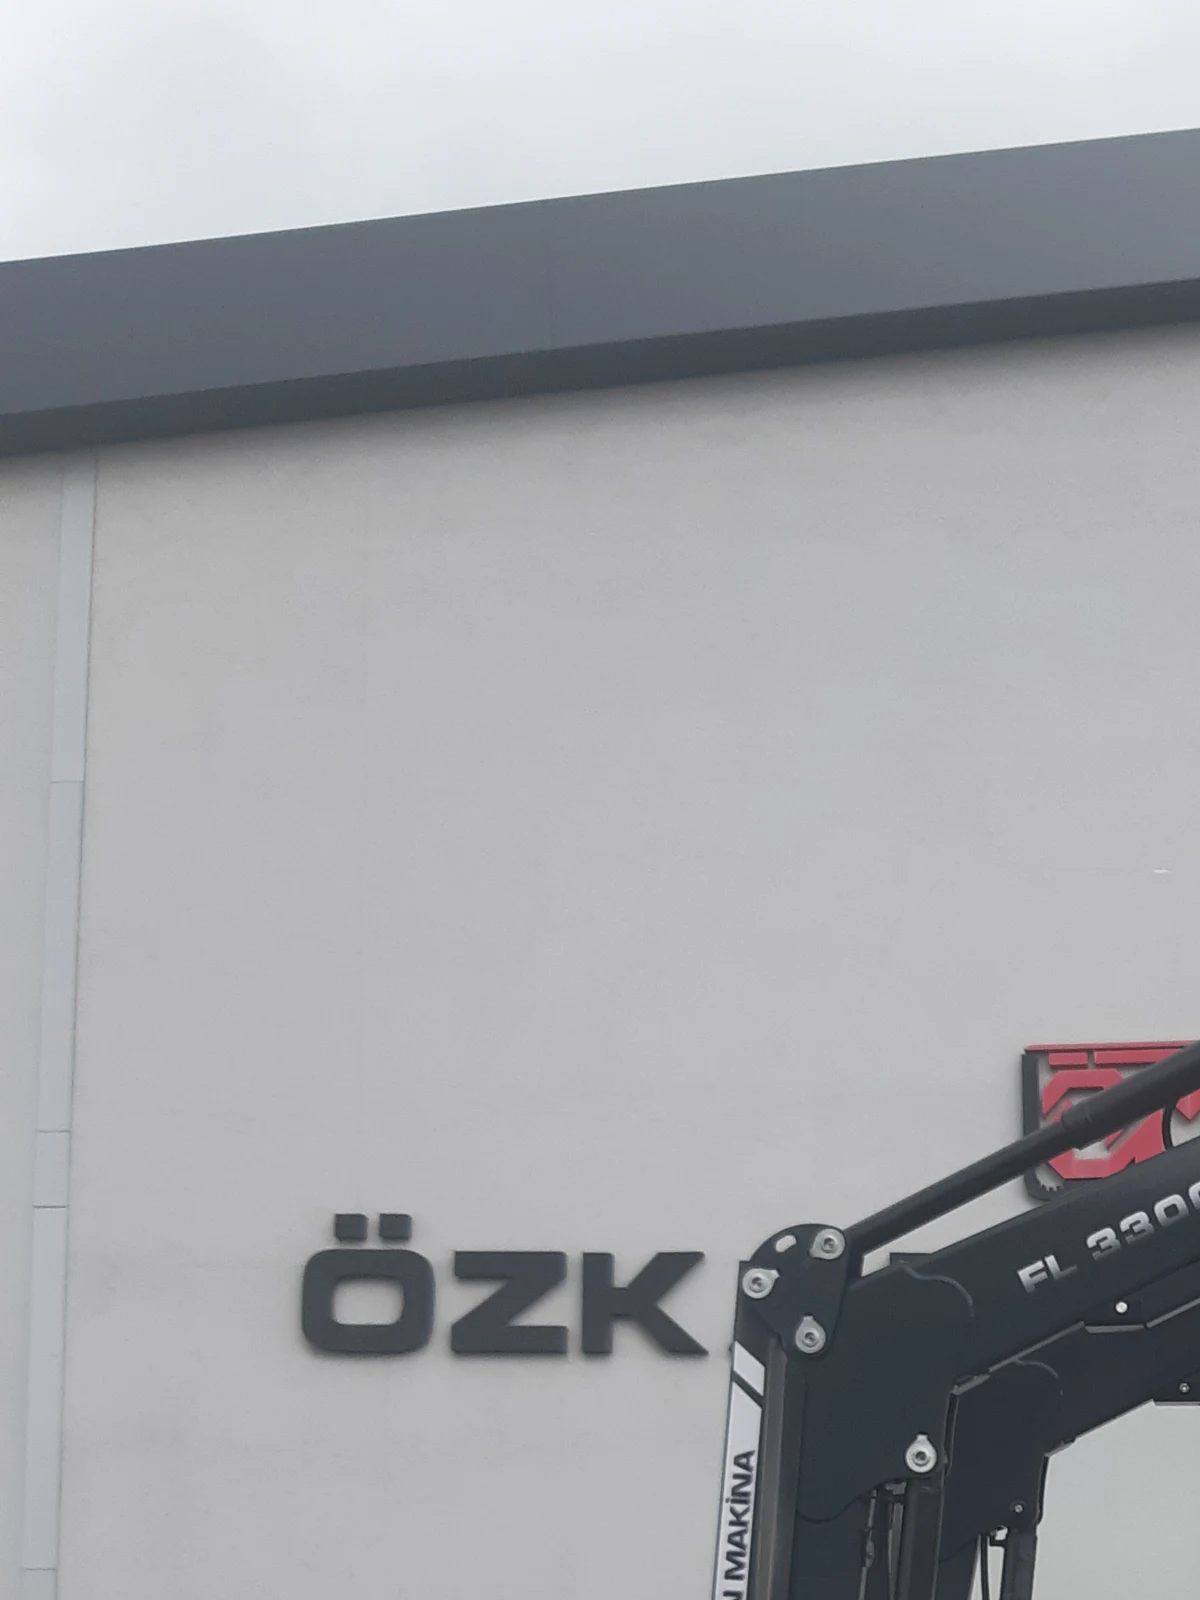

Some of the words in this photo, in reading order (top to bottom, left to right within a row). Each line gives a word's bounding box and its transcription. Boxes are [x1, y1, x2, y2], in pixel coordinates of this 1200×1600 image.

[301, 1212, 710, 1356] ÖZK
[1016, 1254, 1078, 1294] FL
[724, 1449, 757, 1582] MAKİNA
